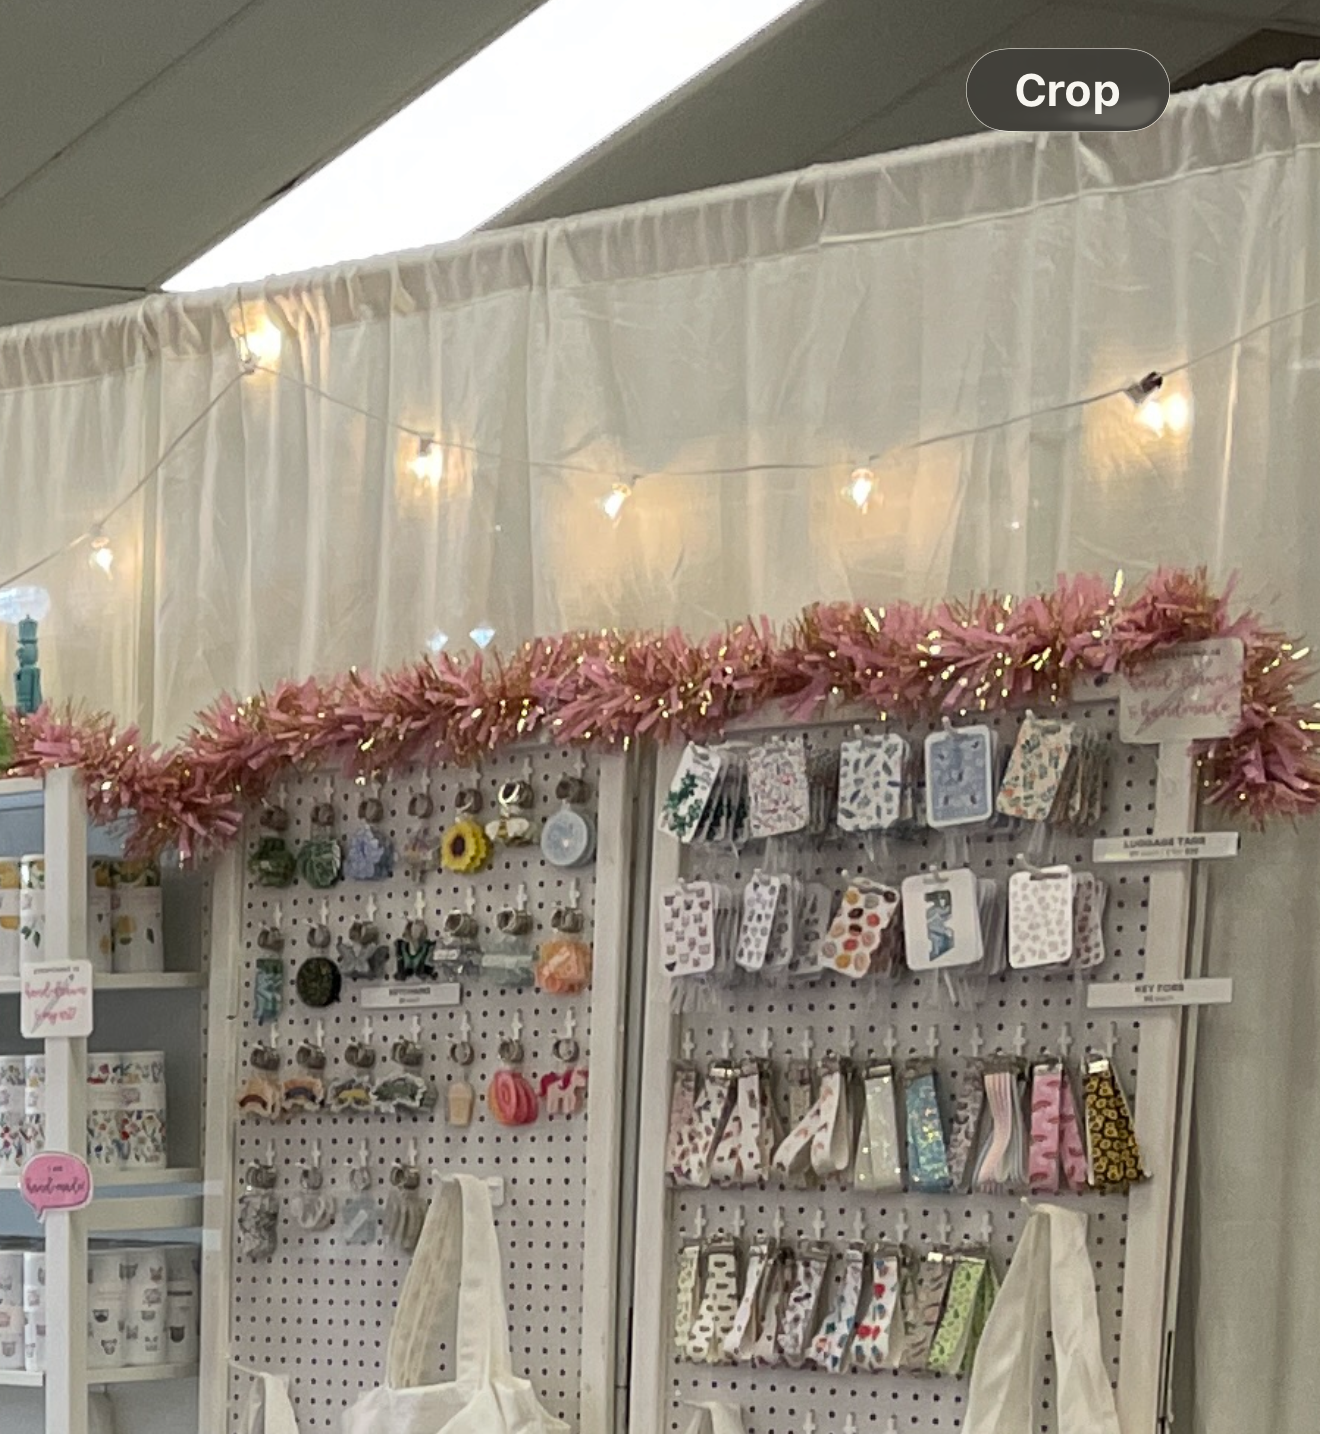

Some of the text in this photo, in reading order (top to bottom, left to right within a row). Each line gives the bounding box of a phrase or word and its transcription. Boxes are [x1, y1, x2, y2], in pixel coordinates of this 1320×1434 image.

[1123, 836, 1206, 848] LUGGAGE TAGS
[924, 889, 955, 962] RVA
[1156, 983, 1184, 992] FOBS
